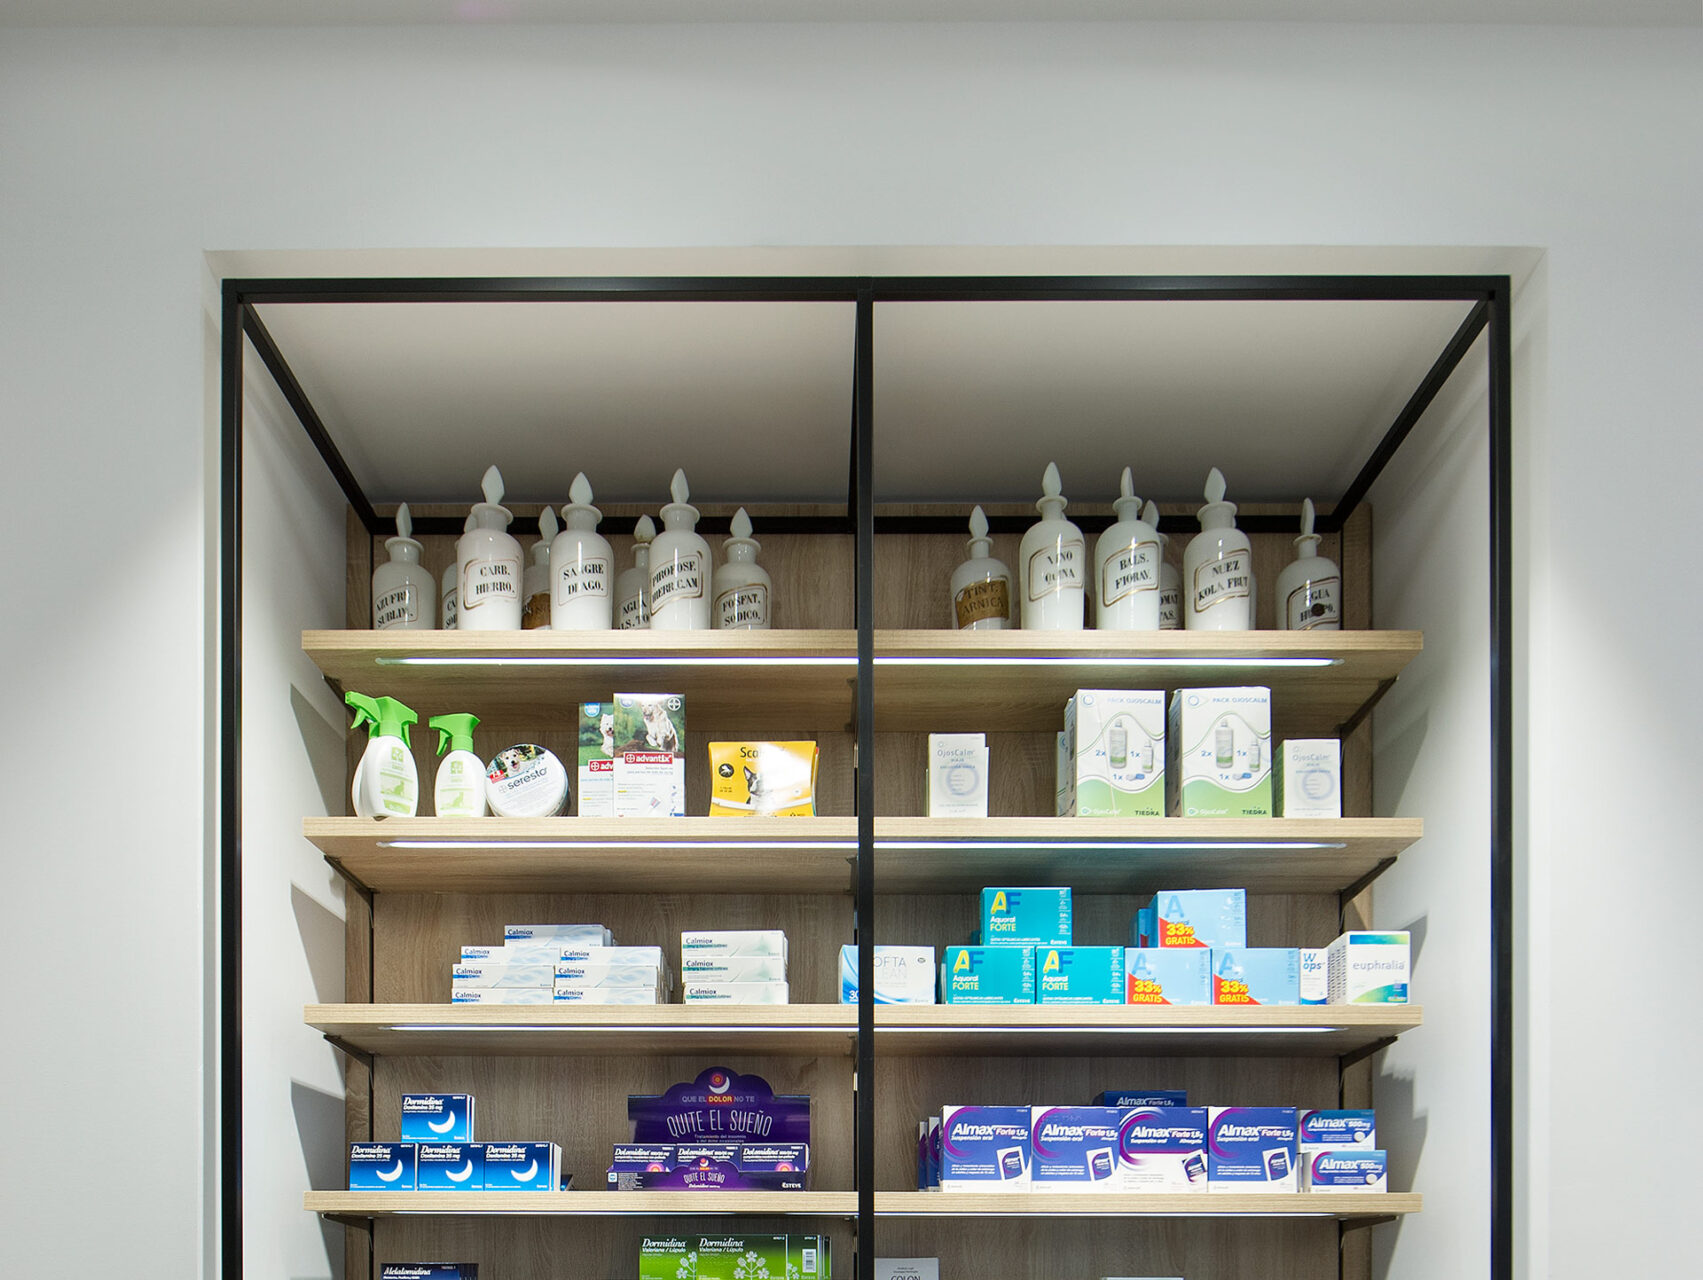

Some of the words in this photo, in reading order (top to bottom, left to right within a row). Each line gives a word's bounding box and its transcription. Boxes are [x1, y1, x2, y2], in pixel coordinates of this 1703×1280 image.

[480, 565, 511, 577] CARB.
[563, 564, 604, 580] SAGRE
[475, 581, 515, 595] HIERRO.
[507, 767, 548, 791] seresto
[990, 891, 1022, 915] AF
[508, 928, 534, 936] Calmiox
[990, 923, 1017, 932] FORTE
[1166, 922, 1195, 936] 33%
[685, 937, 713, 945] Calmiox
[1165, 936, 1197, 946] GRATIS
[464, 948, 490, 957] Calmiox
[564, 950, 590, 958] Calmiox
[953, 950, 985, 974] AF
[1043, 950, 1075, 974] AF
[1352, 960, 1406, 972] euphralia
[456, 968, 482, 976] Calmiox
[558, 967, 585, 976] Calmiox
[689, 987, 717, 995] Calmiox
[952, 982, 980, 991] FORTE
[1042, 982, 1069, 991] FORTE
[1134, 980, 1163, 994] 33%
[1220, 980, 1249, 994] 33%
[455, 991, 481, 999] Calmiox
[557, 989, 584, 997] Calmiox
[1132, 994, 1163, 1003] GRATIS
[1219, 994, 1250, 1003] GRATIS
[402, 1096, 444, 1106] Dormidina
[1116, 1096, 1147, 1106] Almax
[666, 1110, 705, 1138] QUITE
[709, 1109, 724, 1131] EL
[730, 1109, 773, 1137] SUEÑO
[1308, 1117, 1346, 1128] Almax
[951, 1123, 994, 1136] Almax
[995, 1127, 1015, 1136] Forte
[1041, 1123, 1084, 1137] Almax
[1085, 1127, 1105, 1136] Forte
[1130, 1126, 1171, 1138] Almax
[1171, 1130, 1190, 1138] Forte
[1217, 1124, 1260, 1137] Almax
[1261, 1128, 1281, 1137] Forte
[350, 1145, 392, 1155] Dormidina
[419, 1145, 461, 1155] Dormidina
[485, 1145, 527, 1155] Dormidina
[1318, 1158, 1357, 1170] Almax
[641, 1237, 686, 1248] Dormidina
[699, 1237, 744, 1248] Dormidina
